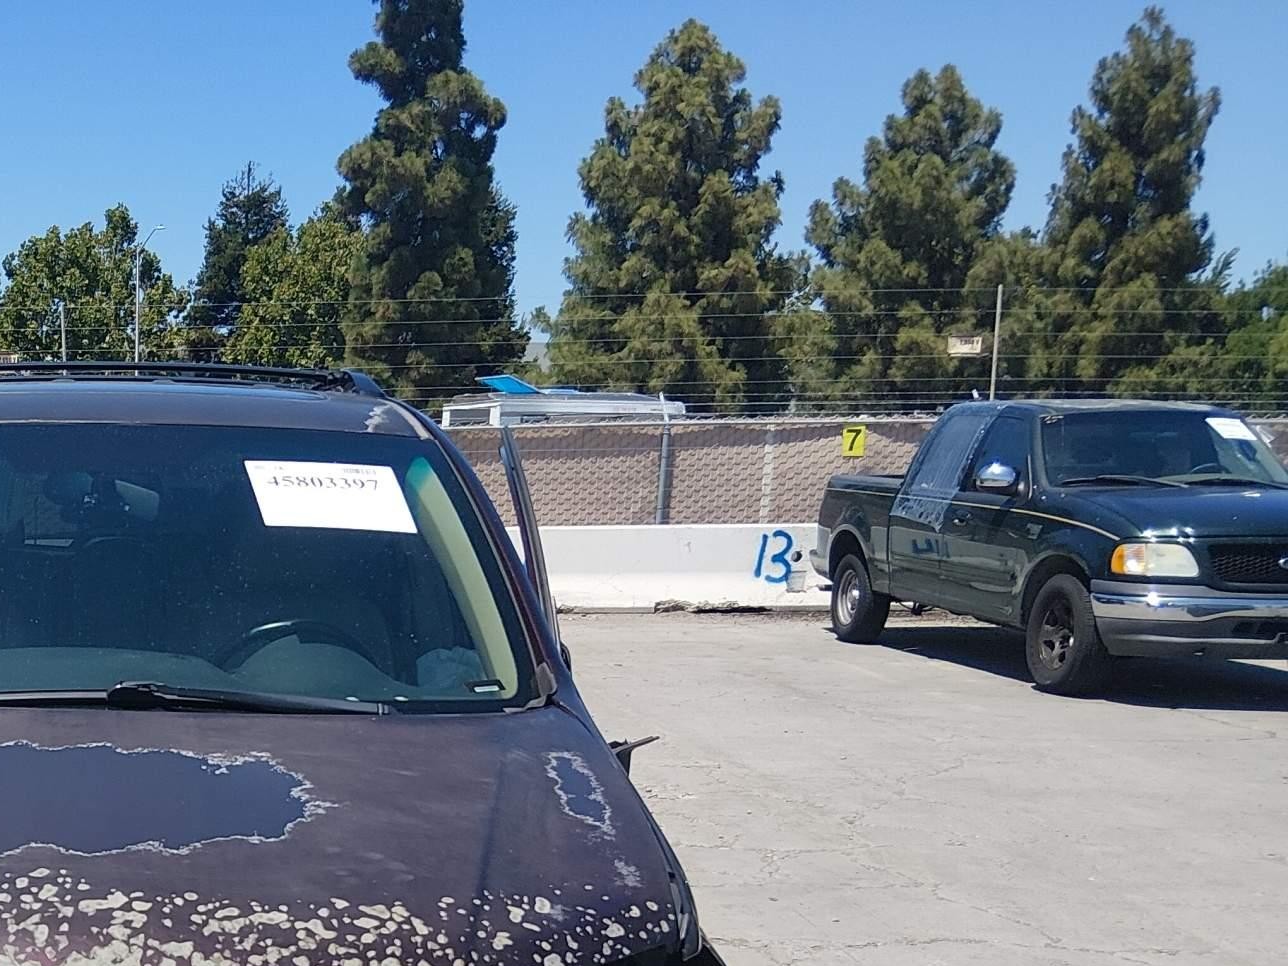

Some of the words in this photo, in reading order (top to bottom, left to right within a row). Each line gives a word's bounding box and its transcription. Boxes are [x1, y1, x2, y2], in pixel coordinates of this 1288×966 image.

[845, 428, 862, 451] 7
[267, 475, 378, 491] 45803397
[754, 530, 793, 583] 13
